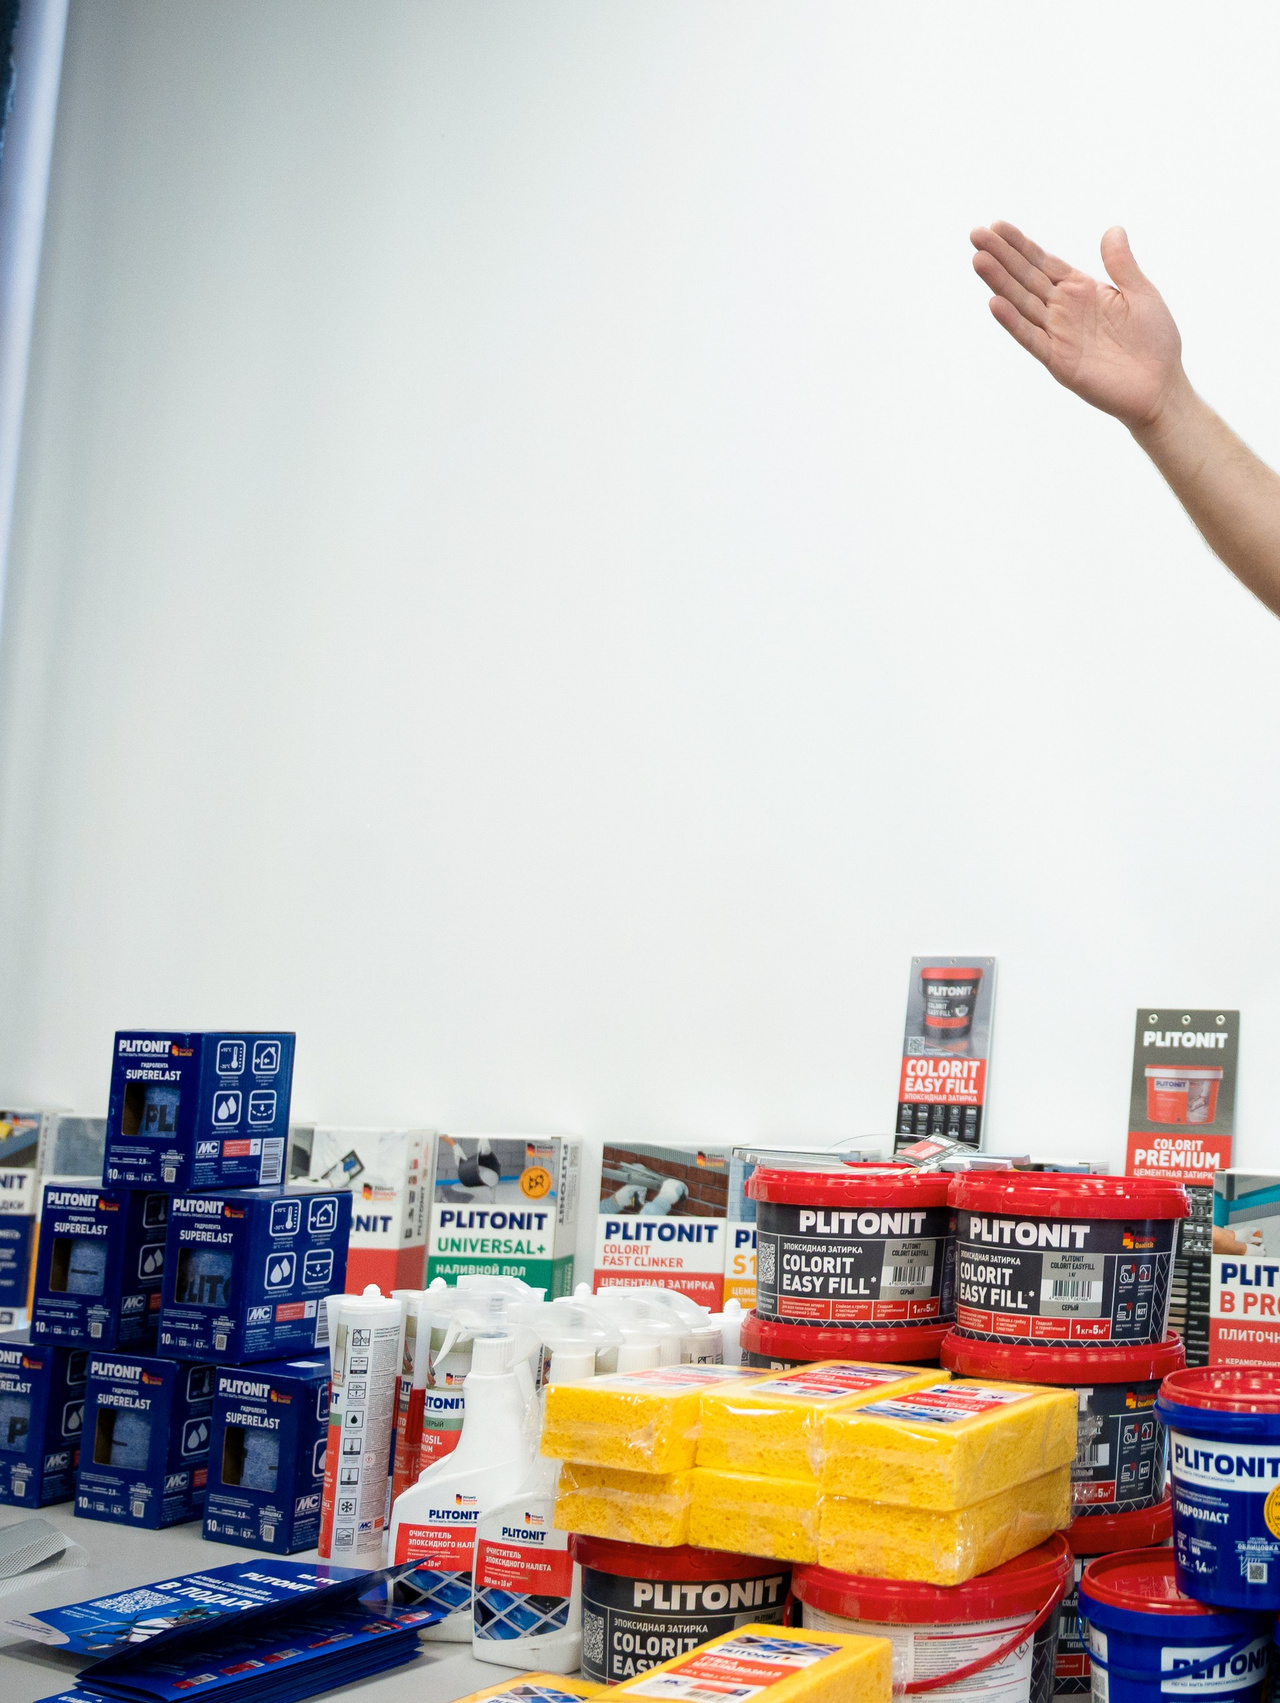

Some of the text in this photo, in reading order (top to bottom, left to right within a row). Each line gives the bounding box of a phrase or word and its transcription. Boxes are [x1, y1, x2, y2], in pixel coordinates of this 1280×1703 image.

[927, 985, 972, 997] PLITONIT
[118, 1039, 172, 1054] PLITONIT
[1143, 1031, 1228, 1048] PLITONIT
[126, 1069, 182, 1081] SUPERELAST
[906, 1060, 980, 1079] COLORIT
[904, 1078, 978, 1094] EASY FILL
[904, 1093, 978, 1103] ЭПОКСИДНАЯ ЗАТИРКА
[1153, 1138, 1204, 1151] COLORIT
[1134, 1149, 1221, 1170] PREMIUM
[1133, 1168, 1215, 1179] ЦЕМЕНТНАЯ ЗАТИРК
[47, 1191, 99, 1207] PLITONIT
[173, 1198, 225, 1214] PLITONIT
[439, 1210, 548, 1231] PLITONIT
[799, 1210, 927, 1235] PLITONIT
[54, 1222, 108, 1236] SUPERELAST
[179, 1230, 234, 1244] SUPERELAST
[605, 1221, 719, 1243] PLITONIT
[969, 1216, 1090, 1248] PLITONIT
[437, 1237, 546, 1255] UNIVERSAL+
[603, 1243, 651, 1255] COLORIT
[783, 1242, 863, 1254] ЭПОКСИДНАЯ ЗАТИРКА
[602, 1255, 684, 1268] FAST CLINKER
[782, 1254, 855, 1274] COLORIT
[960, 1250, 1021, 1266] ЭПОКСИДНАЯ ЗАТИРКА
[1061, 1254, 1085, 1262] PLITONIT
[436, 1263, 526, 1277] НАЛИВНОЙ ПОЛ
[960, 1262, 1013, 1286] COLORIT
[1072, 1263, 1095, 1271] EASYFILL
[601, 1277, 715, 1290] ЦЕМЕНТНАЯ ЗАТИРКА
[782, 1274, 825, 1293] EASY
[960, 1283, 989, 1306] EASY
[91, 1361, 142, 1379] PLITONIT
[1225, 1357, 1280, 1367] КЕРАМОГРАНИТ
[0, 1382, 32, 1394] RELAST
[219, 1378, 270, 1397] PLITONIT
[97, 1393, 151, 1410] SUPERELAST
[225, 1412, 280, 1430] SUPERELAST
[428, 1509, 480, 1520] PLITONIT
[1176, 1500, 1230, 1525] ГИДРОЭЛАСТ
[409, 1529, 452, 1539] ОЧИСТИТЕЛЬ
[502, 1526, 547, 1541] PLITONIT
[408, 1538, 475, 1549] ЭПОКСИДНОГО НАЛЕ
[486, 1546, 522, 1559] ОЧИСТИТЕЛЬ
[485, 1556, 552, 1572] ЭПОКСИДНОГО НАЛЕТА
[239, 1572, 318, 1592] PLITONIT
[633, 1577, 784, 1611] PLITONIT
[613, 1618, 709, 1633] ЭПОКСИДНАЯ ЗАТИРКА
[613, 1631, 698, 1659] COLORIT
